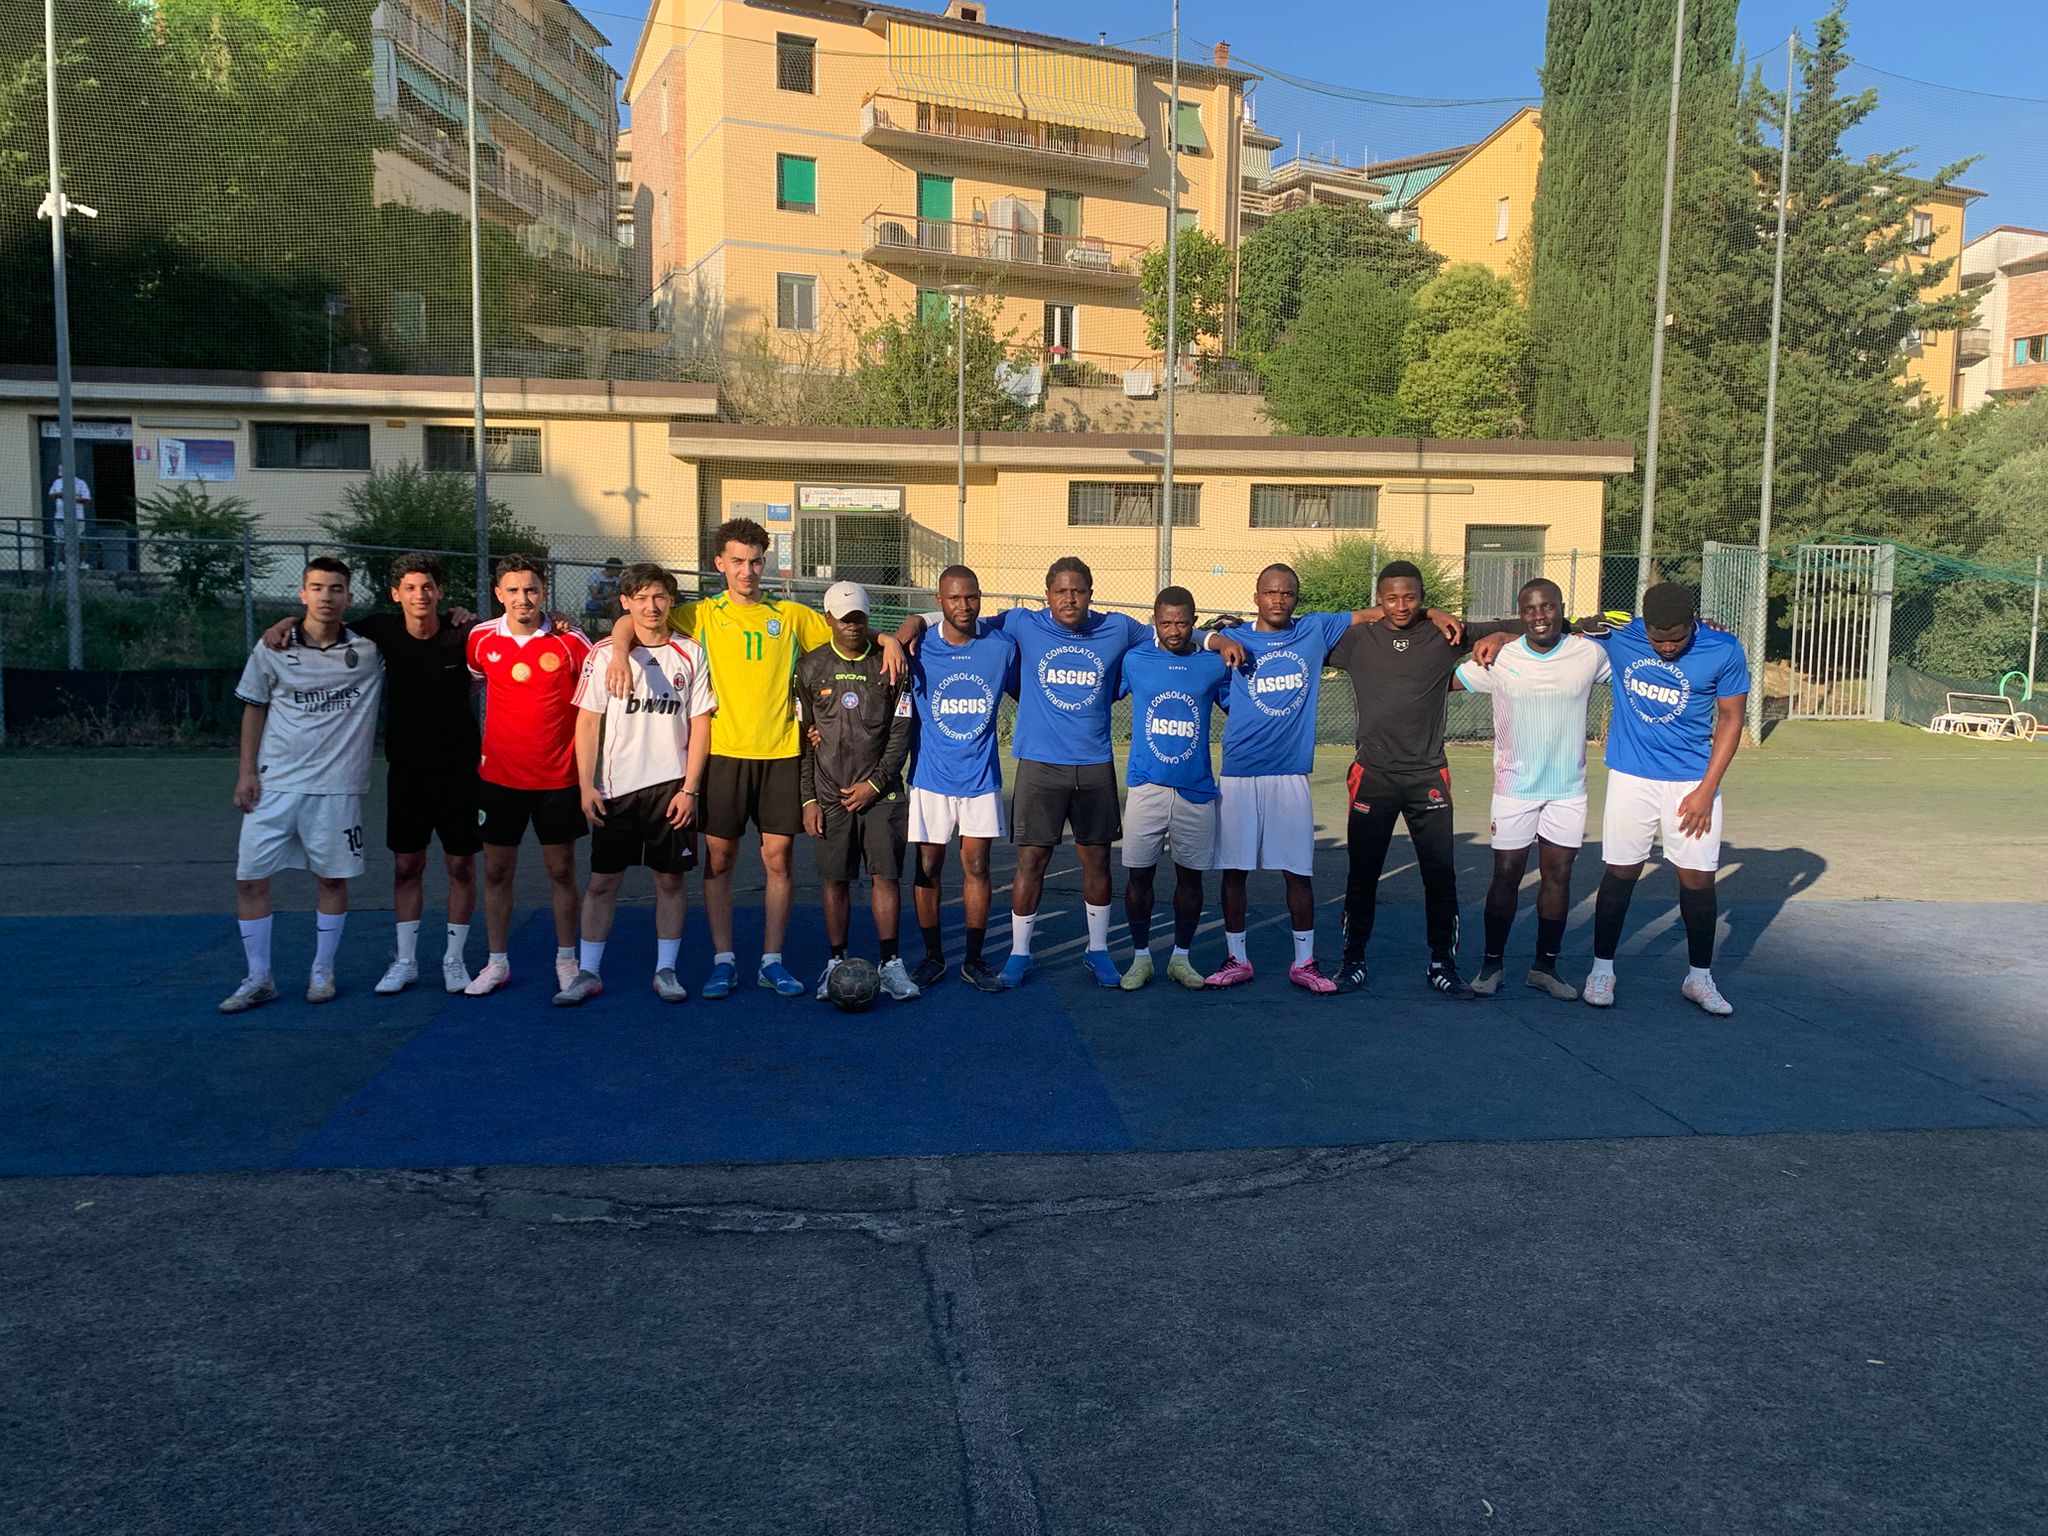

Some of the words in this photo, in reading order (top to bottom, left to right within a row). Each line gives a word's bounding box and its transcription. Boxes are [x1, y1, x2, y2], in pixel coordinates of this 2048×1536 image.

[743, 630, 762, 661] 11
[1045, 645, 1095, 660] CONSOLATO
[1046, 668, 1097, 686] ASCUS
[1631, 658, 1684, 679] CONSOLATO
[938, 672, 984, 690] CONSOLATO
[1256, 672, 1304, 694] ASCUS
[293, 687, 361, 704] Emirates
[1044, 687, 1082, 711] CAMERUN
[1081, 694, 1096, 706] DEL
[1151, 690, 1195, 708] CONSOLATO
[1630, 678, 1681, 705] ASCUS
[625, 691, 681, 715] bwin
[931, 689, 943, 721] FIRENZE
[940, 698, 987, 714] ASCUS
[1254, 699, 1291, 717] CAMERUN
[936, 721, 973, 740] CAMERUN
[972, 722, 987, 736] DEL
[1145, 706, 1155, 741] FIRENZE
[1151, 717, 1195, 738] ASCUS
[1148, 741, 1180, 764] CAMERUN
[1179, 748, 1193, 761] DEL
[343, 825, 363, 852] 10
